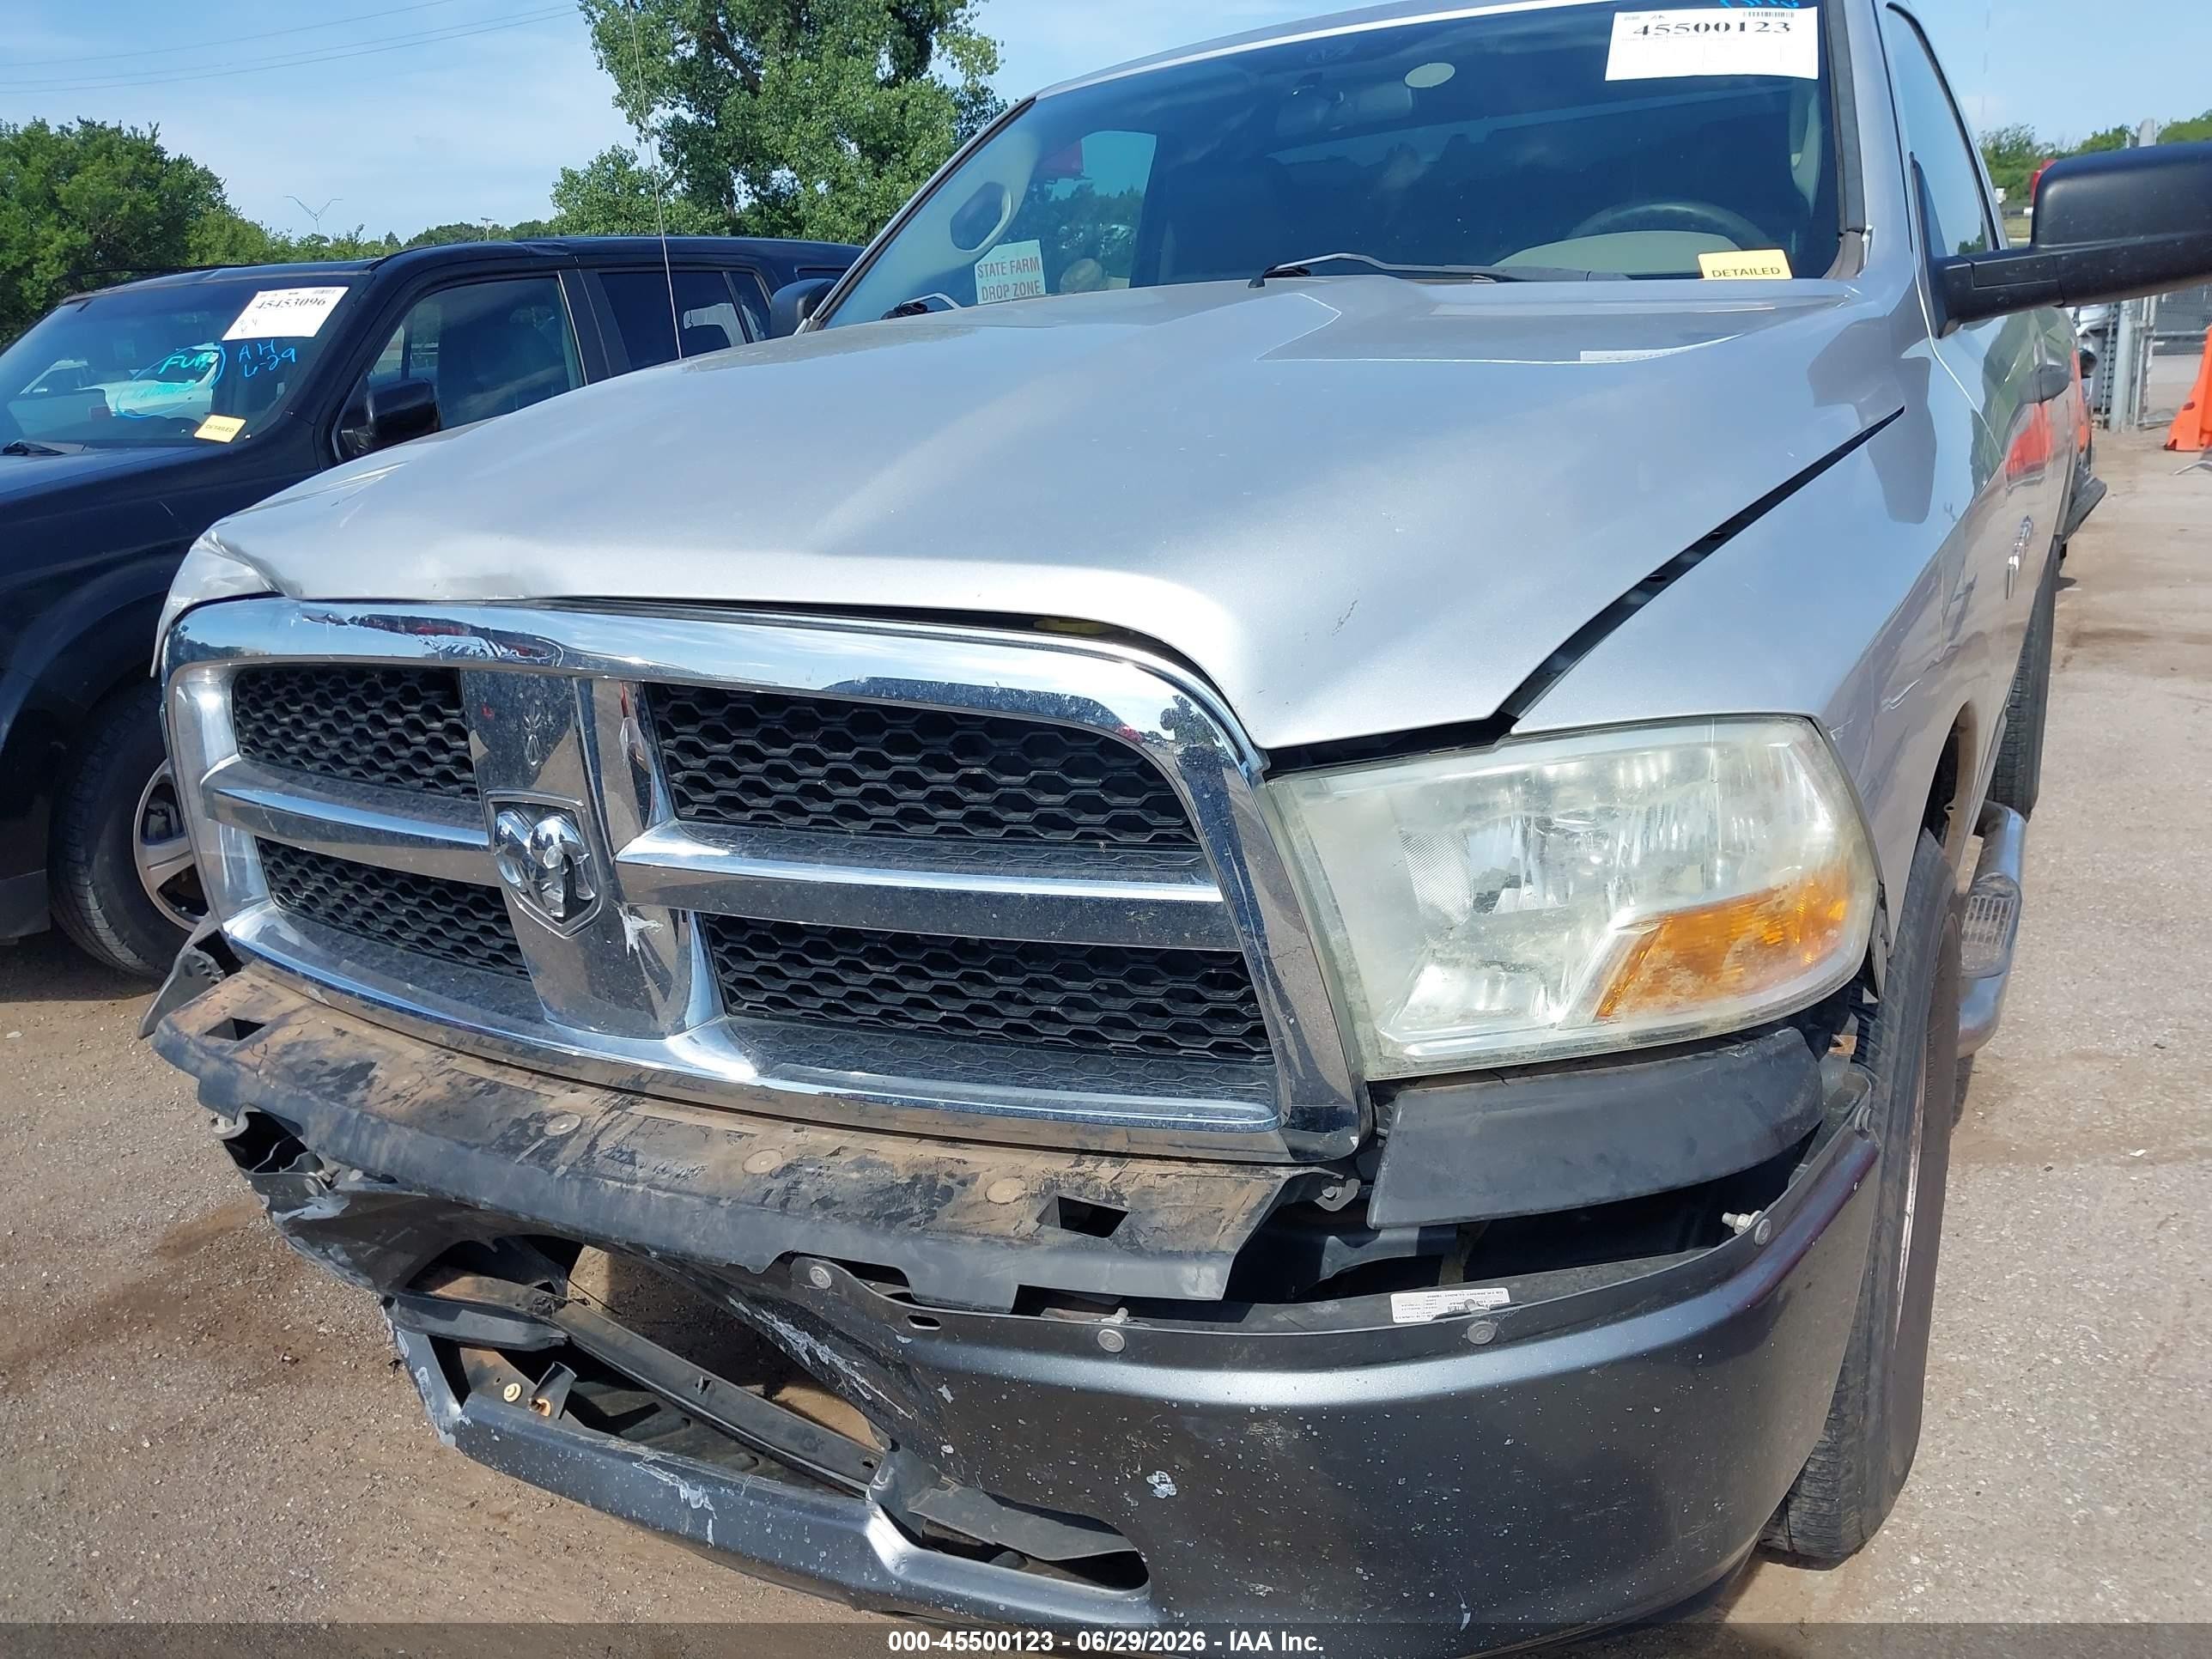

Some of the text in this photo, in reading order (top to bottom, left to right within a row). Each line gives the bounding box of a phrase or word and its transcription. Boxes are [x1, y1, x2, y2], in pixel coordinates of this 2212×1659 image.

[1632, 21, 1791, 36] 45500123
[977, 256, 1040, 278] STATE FARM
[1711, 267, 1781, 277] DETAILED
[981, 280, 1041, 301] DROP ZONE
[255, 297, 326, 309] 45453096
